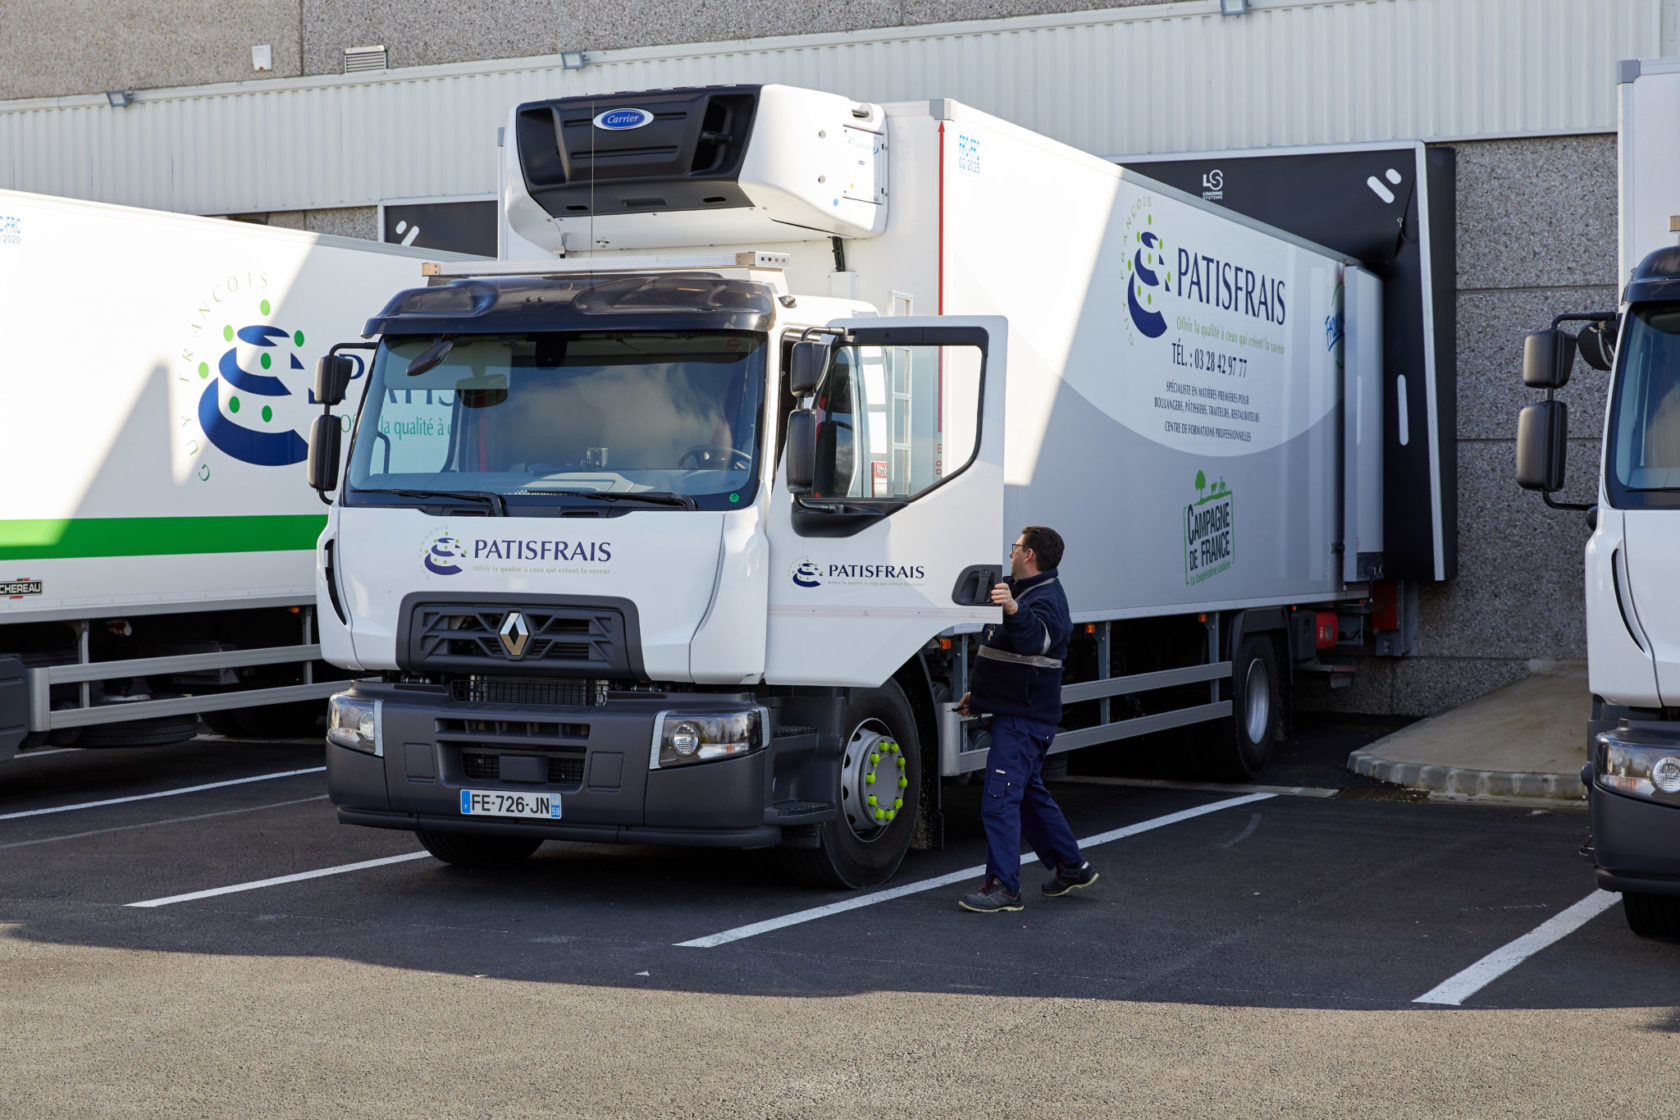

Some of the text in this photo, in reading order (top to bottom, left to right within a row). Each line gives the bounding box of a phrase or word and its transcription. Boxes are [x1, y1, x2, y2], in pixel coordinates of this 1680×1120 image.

[607, 114, 640, 124] Carrier
[1203, 169, 1223, 190] LS
[1178, 247, 1286, 326] PATISFRAIS
[1171, 338, 1188, 367] TÉL.
[1194, 348, 1204, 370] 03
[1206, 350, 1215, 373] 28
[1217, 353, 1226, 375] 42
[1228, 355, 1237, 376] 97
[1239, 358, 1247, 379] 77
[1166, 379, 1191, 396] SPÉCIALISTE
[1191, 386, 1198, 397] EN
[1238, 394, 1249, 406] POUR
[380, 416, 391, 435] la
[393, 416, 434, 440] qualité
[437, 417, 445, 436] à
[1164, 420, 1252, 442] CENTRE DE FORMATIONS PROFESSIONNELLES
[1187, 502, 1230, 546] CAMPAGNE
[474, 539, 612, 562] PATISFRAIS
[1189, 530, 1230, 571] DE FRANCE
[829, 564, 925, 579] PATISFRAIS
[0, 583, 41, 594] CHEREAU
[551, 807, 560, 816] 59
